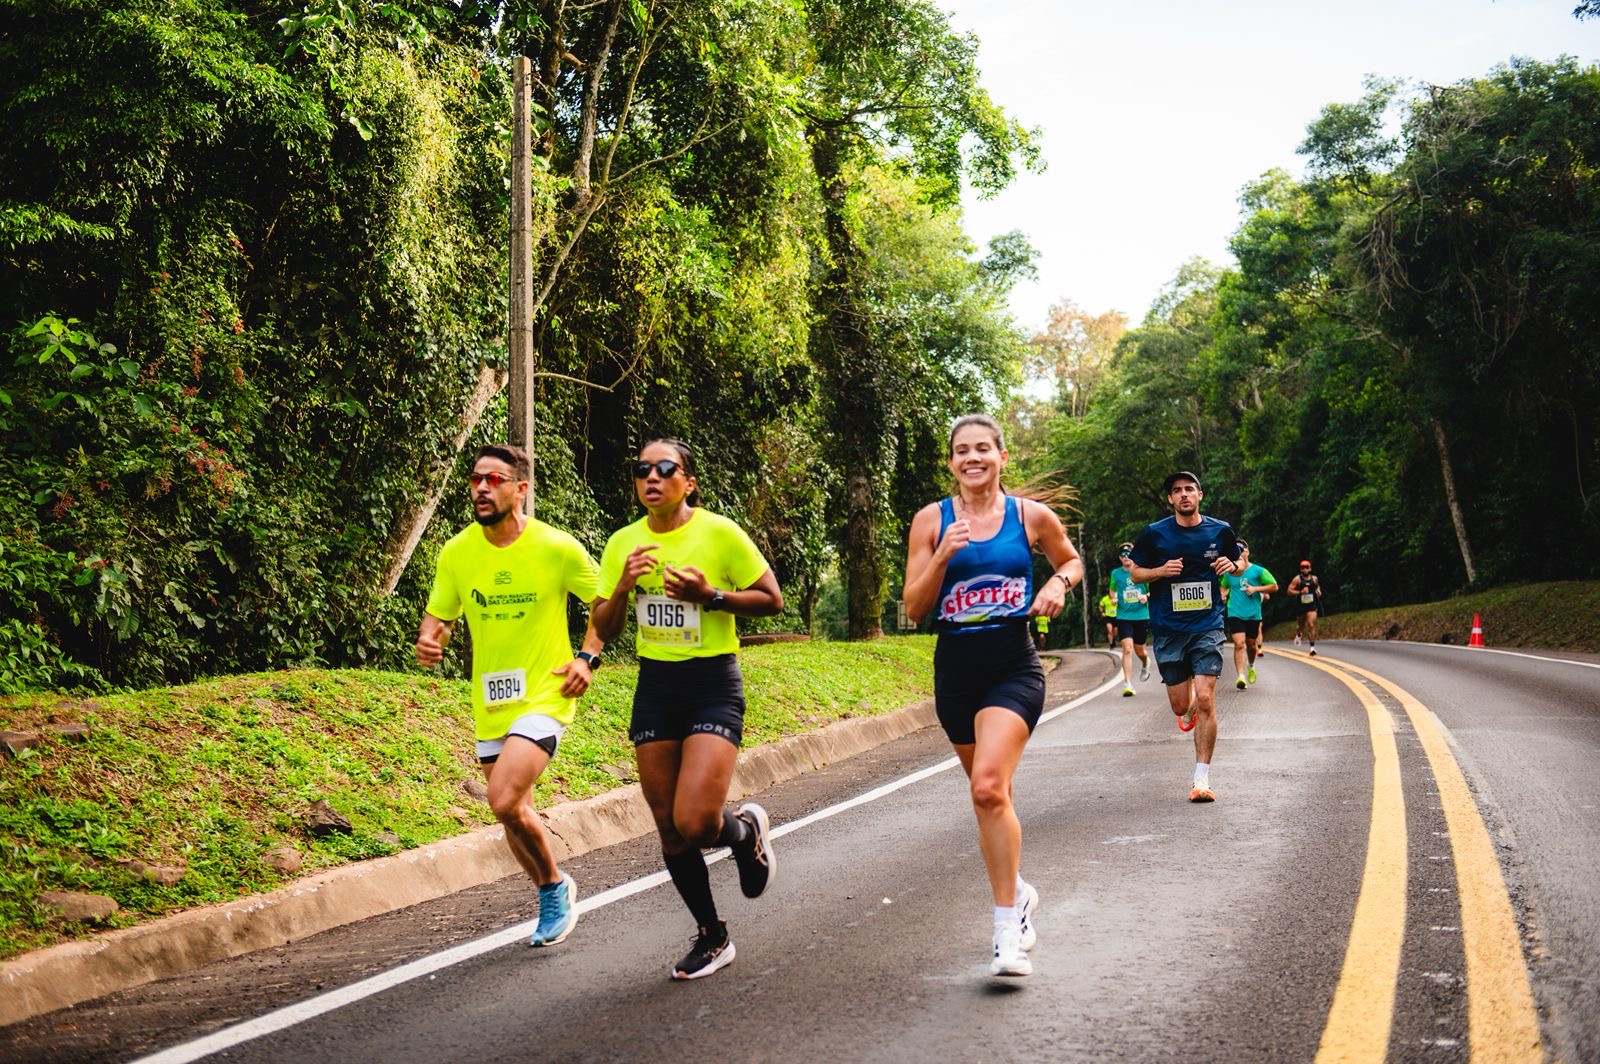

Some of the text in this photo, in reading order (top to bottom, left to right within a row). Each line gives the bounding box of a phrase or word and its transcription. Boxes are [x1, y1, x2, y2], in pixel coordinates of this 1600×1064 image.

[501, 596, 537, 605] CATARATAS
[1179, 587, 1204, 600] 8606
[647, 603, 684, 627] 9156
[488, 677, 521, 701] 8684
[692, 723, 732, 737] MORE
